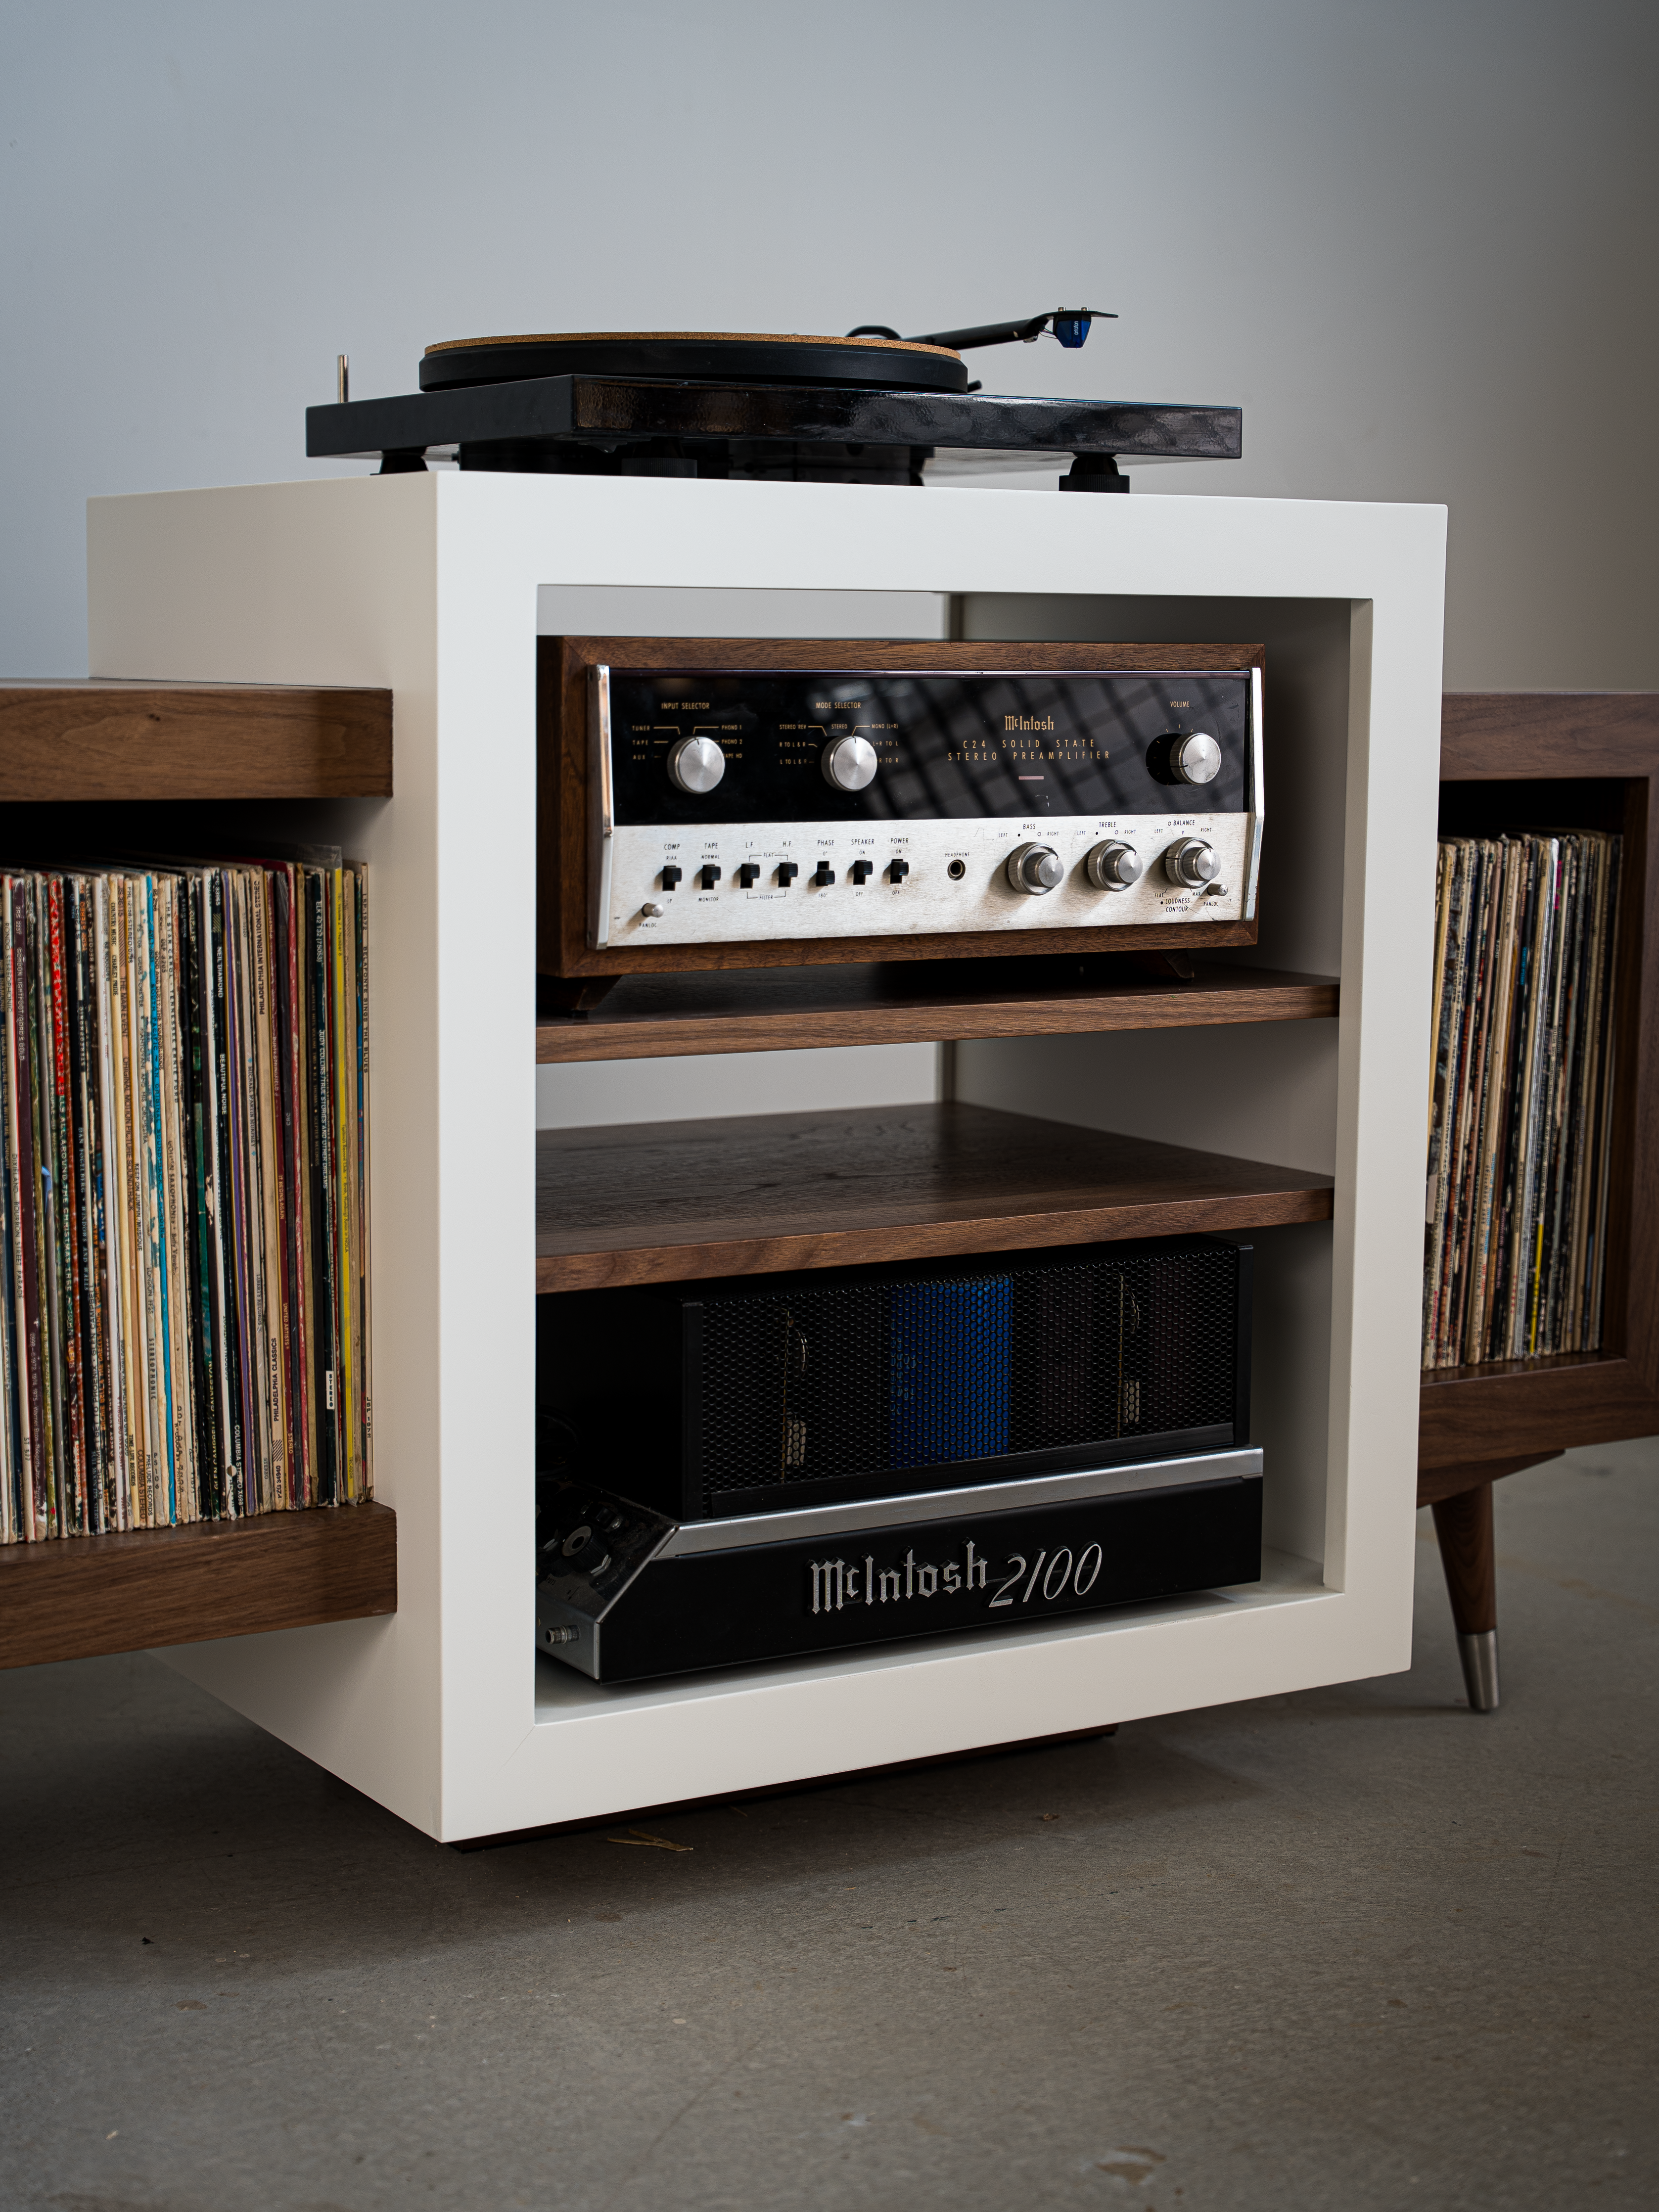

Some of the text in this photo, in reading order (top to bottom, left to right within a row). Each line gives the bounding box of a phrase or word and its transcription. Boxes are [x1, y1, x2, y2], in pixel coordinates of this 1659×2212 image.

[1005, 716, 1054, 730] McIntosh
[948, 751, 1109, 761] STEREO PREAMPLIFIER
[118, 886, 124, 895] JS
[255, 909, 263, 964] INTERNATIONAL
[137, 1450, 145, 1487] COLUMBIA
[810, 1540, 1102, 1613] McIntosh 2100
